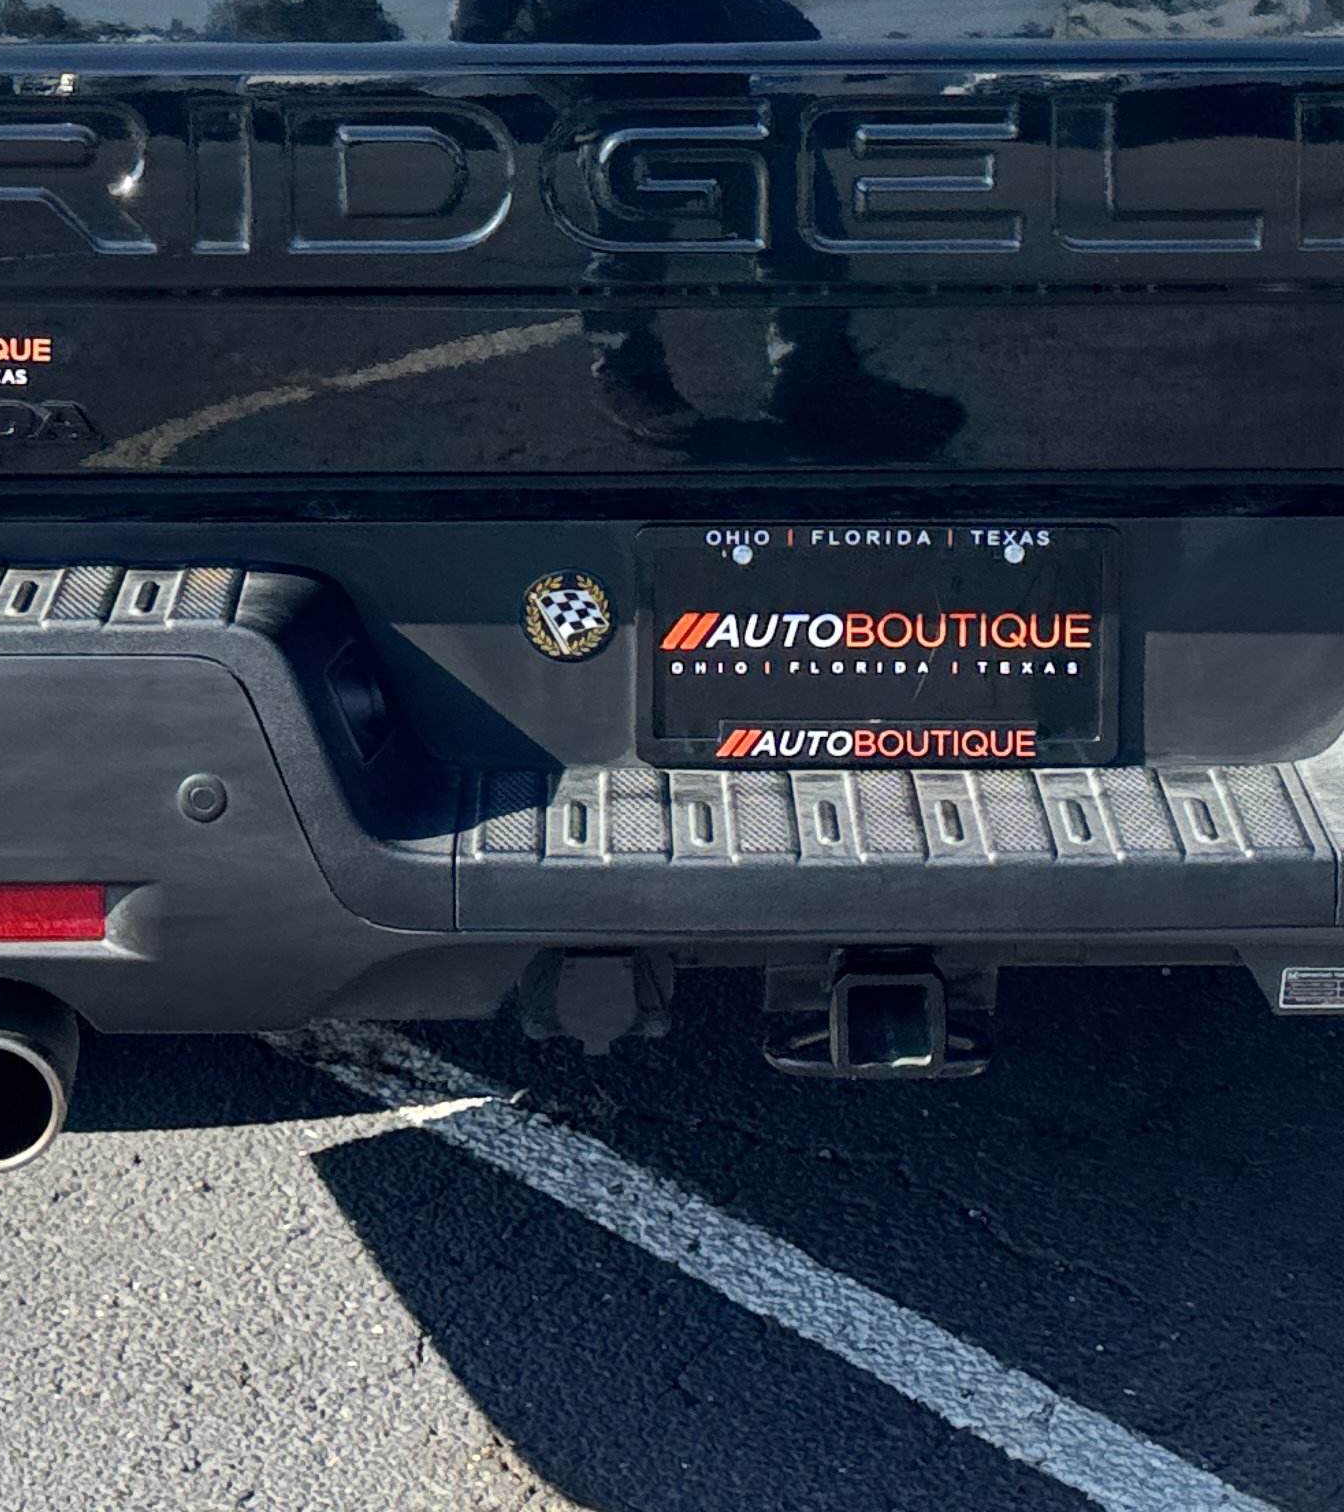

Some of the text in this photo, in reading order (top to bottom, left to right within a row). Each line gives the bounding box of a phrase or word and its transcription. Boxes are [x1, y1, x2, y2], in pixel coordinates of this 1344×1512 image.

[705, 529, 1051, 546] OHIO FLORIDA TEXAS
[707, 612, 1093, 650] AUTOBOUTIQUE
[671, 661, 1078, 675] OHIO FLORIDA TEXAS
[750, 728, 1037, 758] AUTOBOUTIQUE
